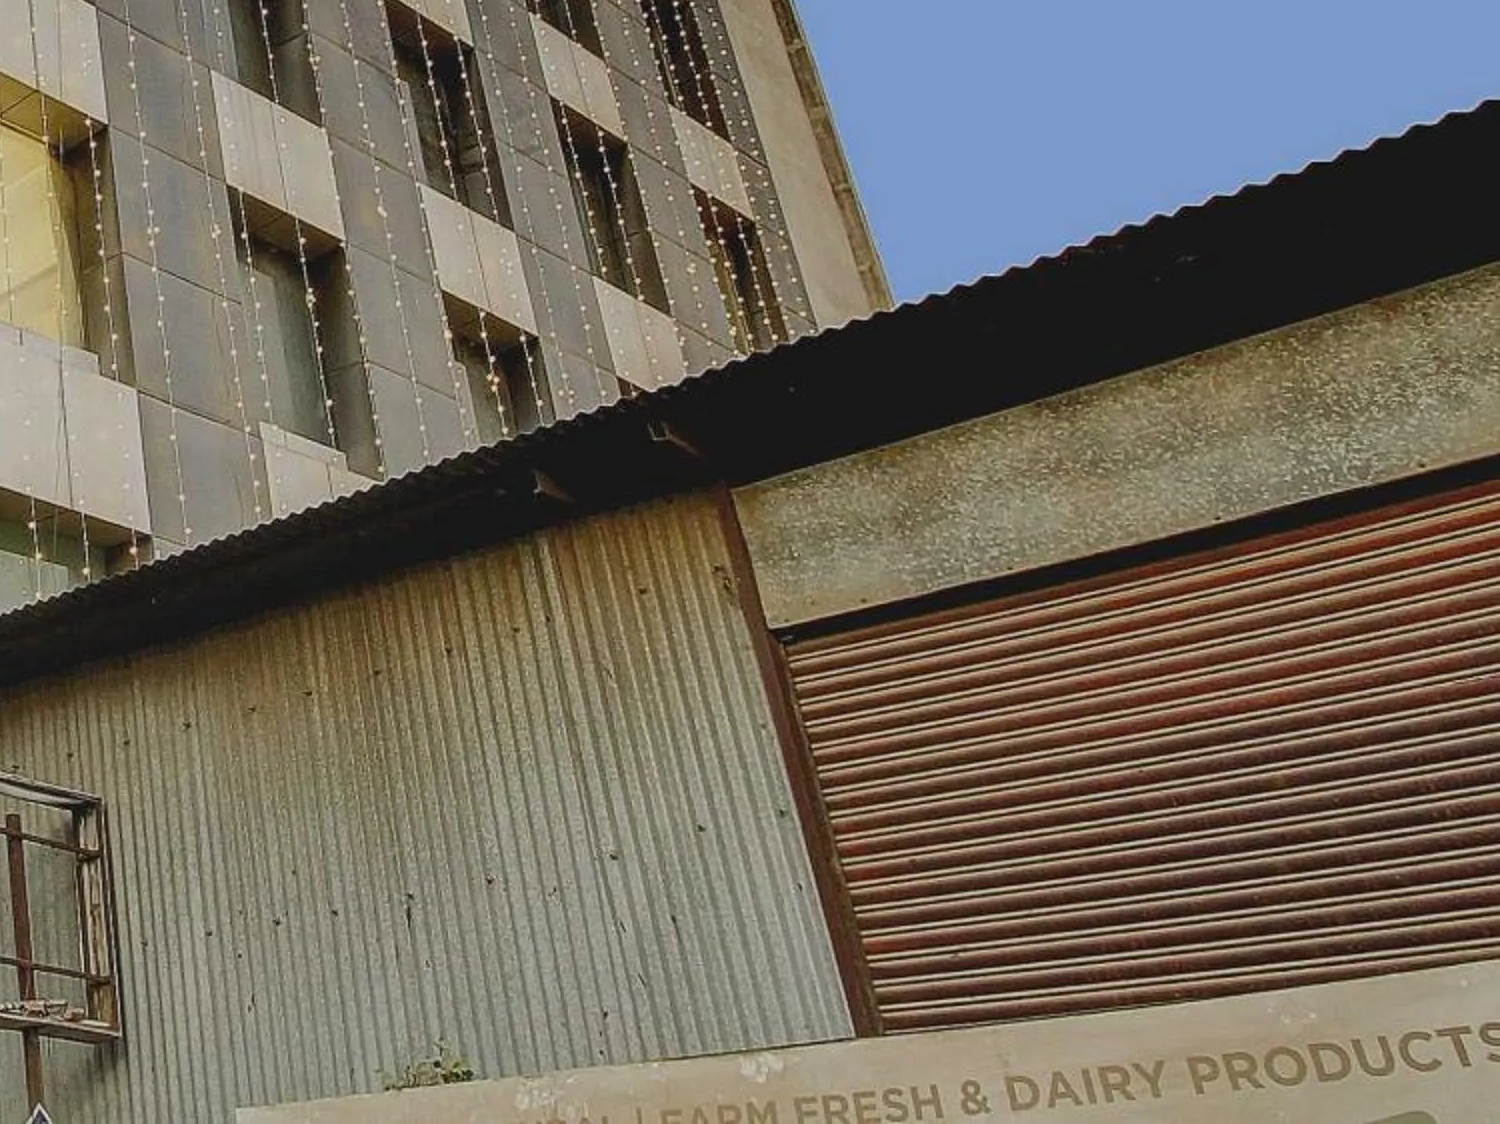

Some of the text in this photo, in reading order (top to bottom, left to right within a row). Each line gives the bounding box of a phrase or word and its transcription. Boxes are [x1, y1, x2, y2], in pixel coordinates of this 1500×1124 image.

[794, 1083, 944, 1124] FRESH
[959, 1079, 992, 1116] &
[1004, 1060, 1166, 1112] DAIRY
[1183, 1021, 1500, 1095] PRODUCTS
